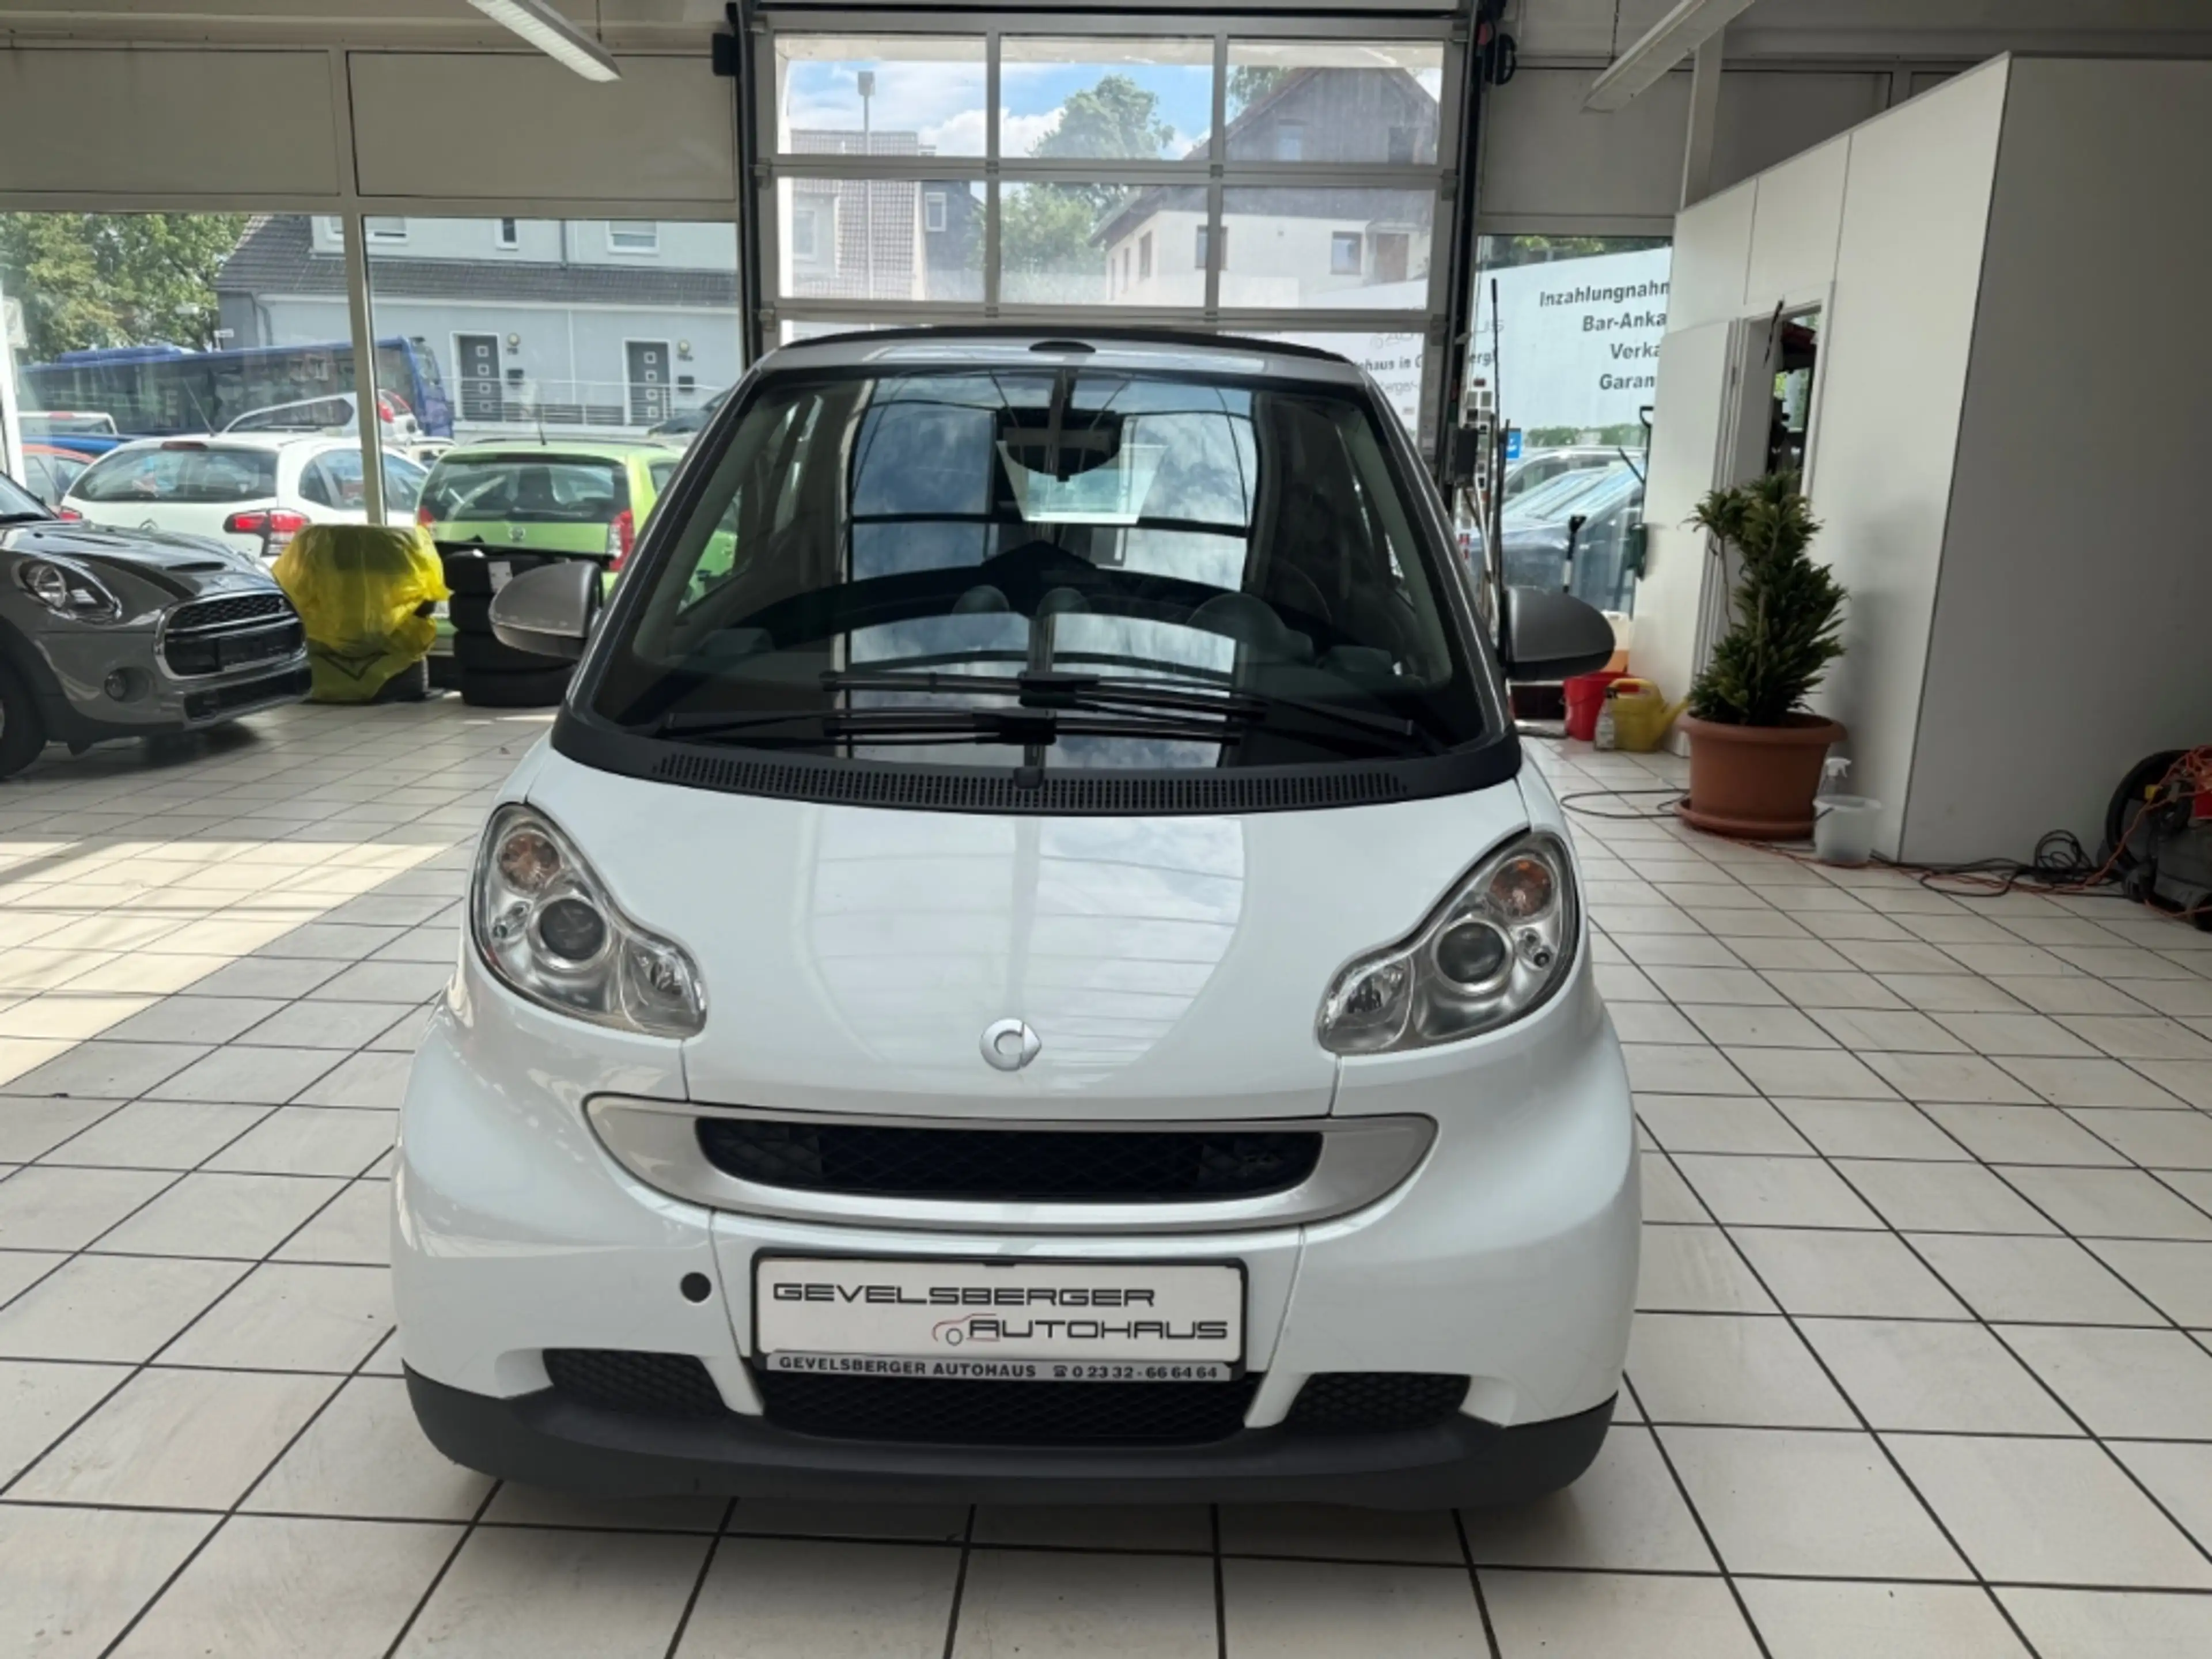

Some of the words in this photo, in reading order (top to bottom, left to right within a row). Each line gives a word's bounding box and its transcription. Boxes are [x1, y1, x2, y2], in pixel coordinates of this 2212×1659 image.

[1582, 311, 1667, 332] Bar-Anka
[1599, 373, 1655, 390] Garan
[773, 1282, 1155, 1307] GEVELSBERGER
[969, 1319, 1228, 1339] AUTOHAUS
[779, 1356, 926, 1375] GEVELSBERGER
[933, 1362, 1036, 1377] AUTOHAUS
